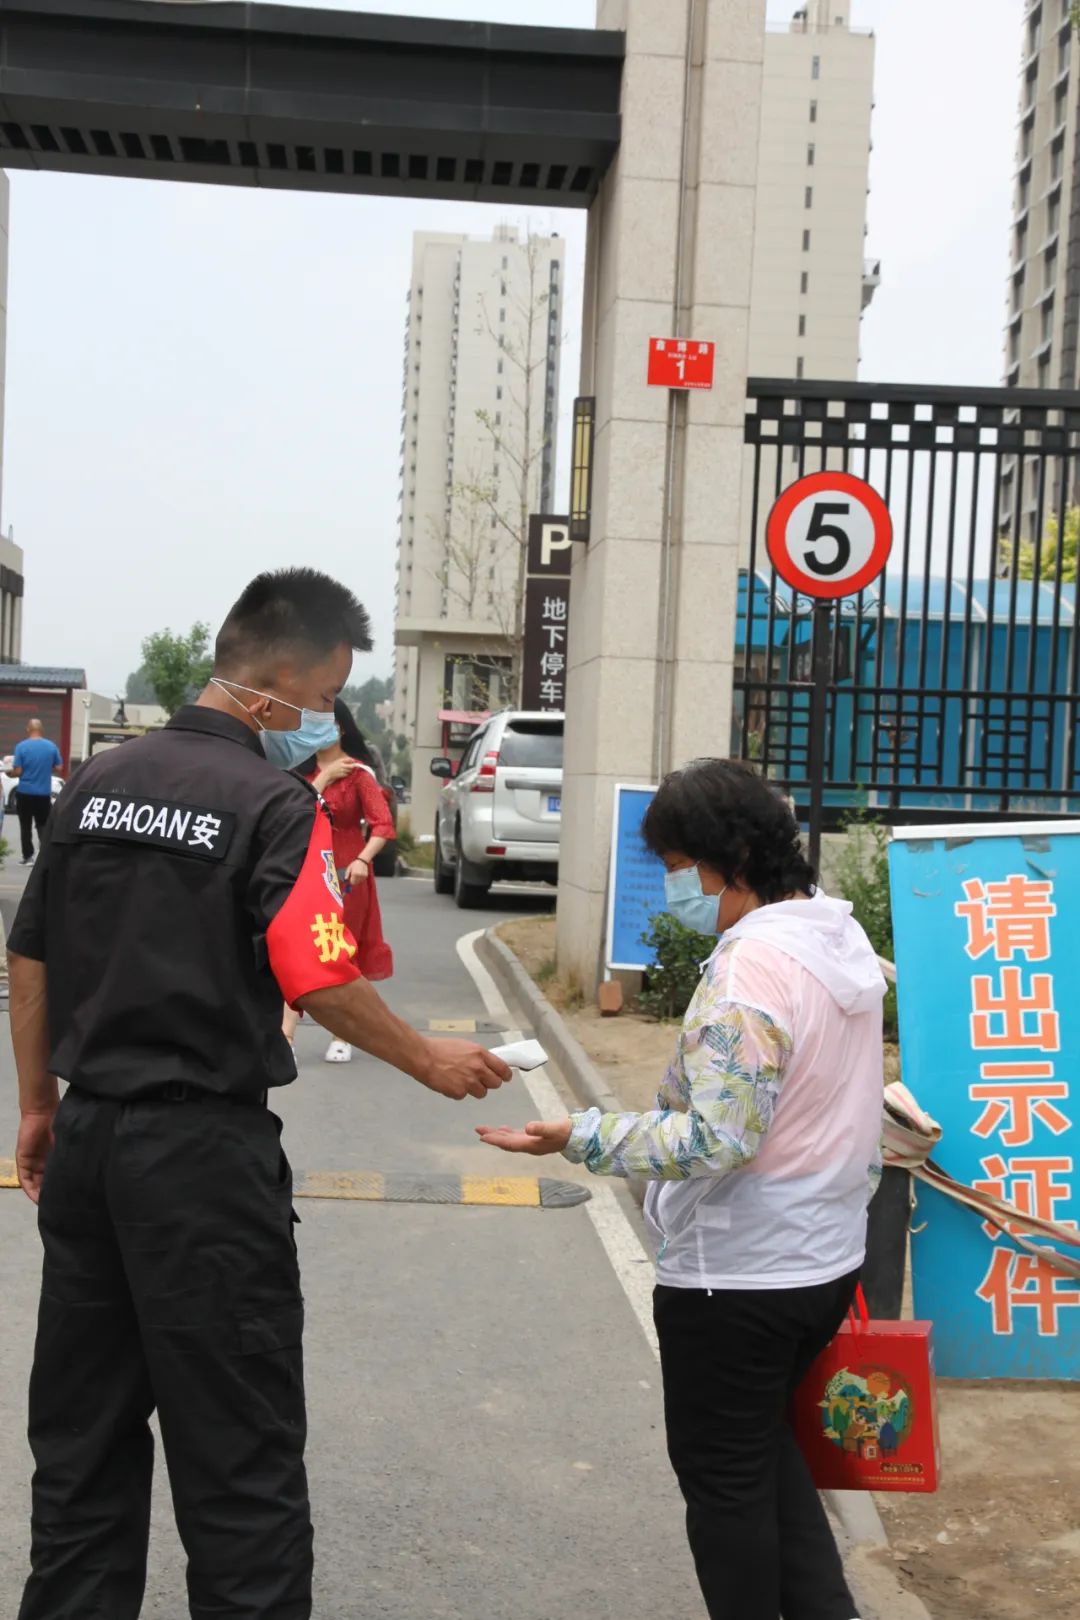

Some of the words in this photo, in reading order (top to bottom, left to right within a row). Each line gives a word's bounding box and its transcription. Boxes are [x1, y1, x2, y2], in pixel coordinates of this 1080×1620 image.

[676, 360, 685, 380] 1
[541, 523, 573, 565] P
[803, 502, 851, 576] 5
[539, 596, 567, 712] 地下停车
[310, 912, 357, 963] 执
[954, 874, 1080, 1336] 请出示证件
